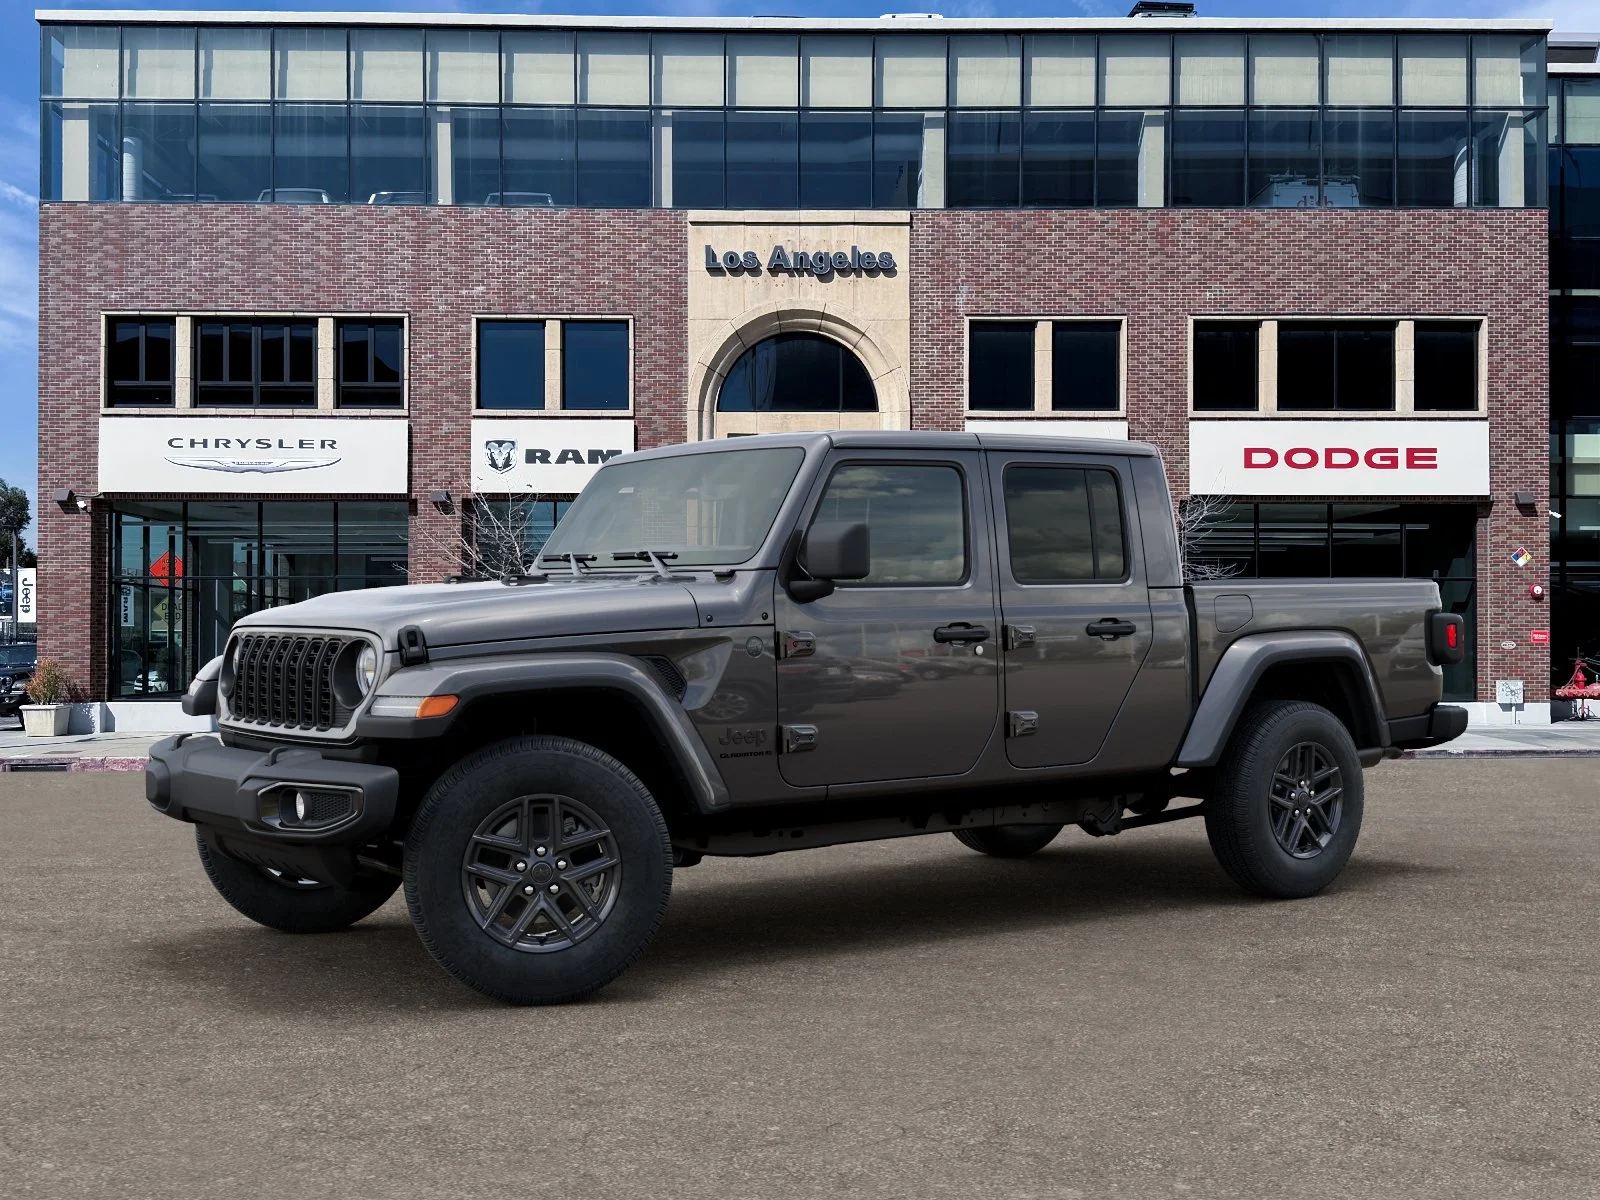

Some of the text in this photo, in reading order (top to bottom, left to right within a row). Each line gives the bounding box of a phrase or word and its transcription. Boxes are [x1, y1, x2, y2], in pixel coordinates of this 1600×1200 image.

[704, 244, 896, 275] Los Angeles
[167, 437, 338, 450] CHRYSLER
[524, 448, 623, 465] RAM
[1243, 447, 1438, 470] DODGE
[20, 577, 34, 614] Jeep
[161, 602, 183, 611] DAD
[164, 612, 181, 620] ED
[718, 727, 768, 747] Jeep
[719, 751, 765, 759] GLADIATOR
